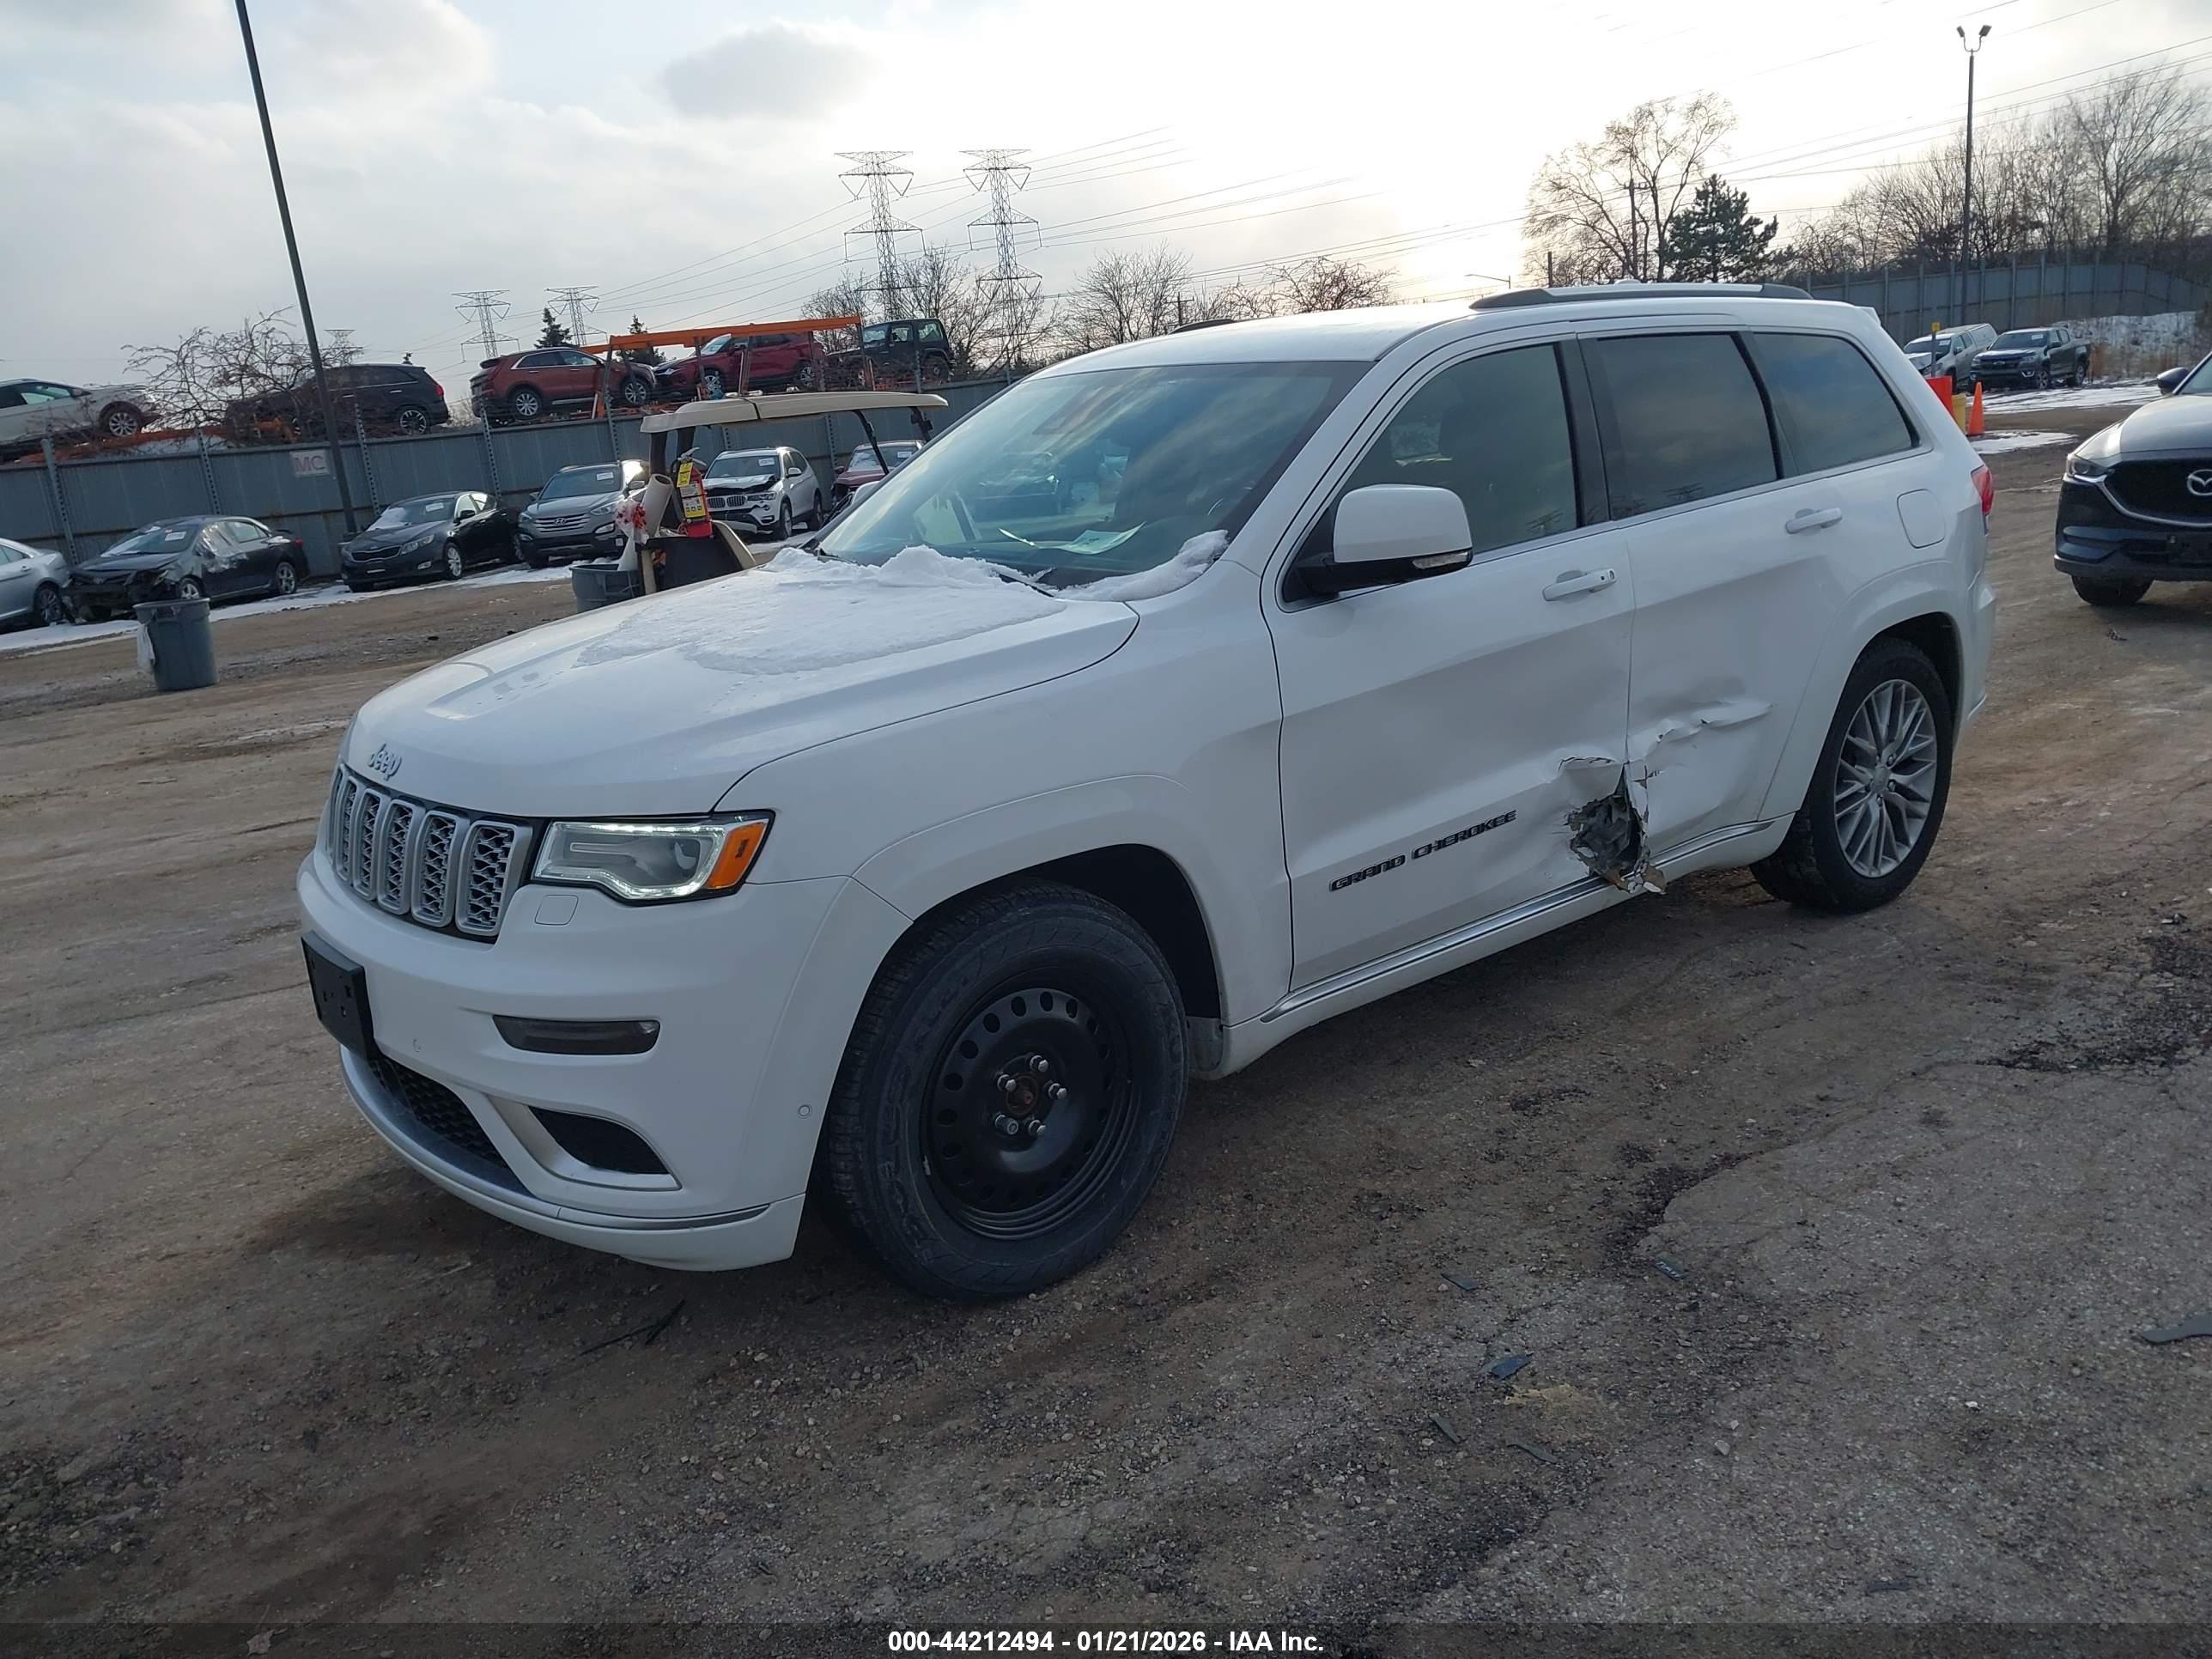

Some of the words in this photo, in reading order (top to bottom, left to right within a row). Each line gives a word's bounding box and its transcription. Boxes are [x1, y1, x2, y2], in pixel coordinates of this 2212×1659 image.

[368, 743, 403, 781] Jeep
[1328, 854, 1407, 892] GRAND
[1411, 810, 1517, 860] CHEROKEE
